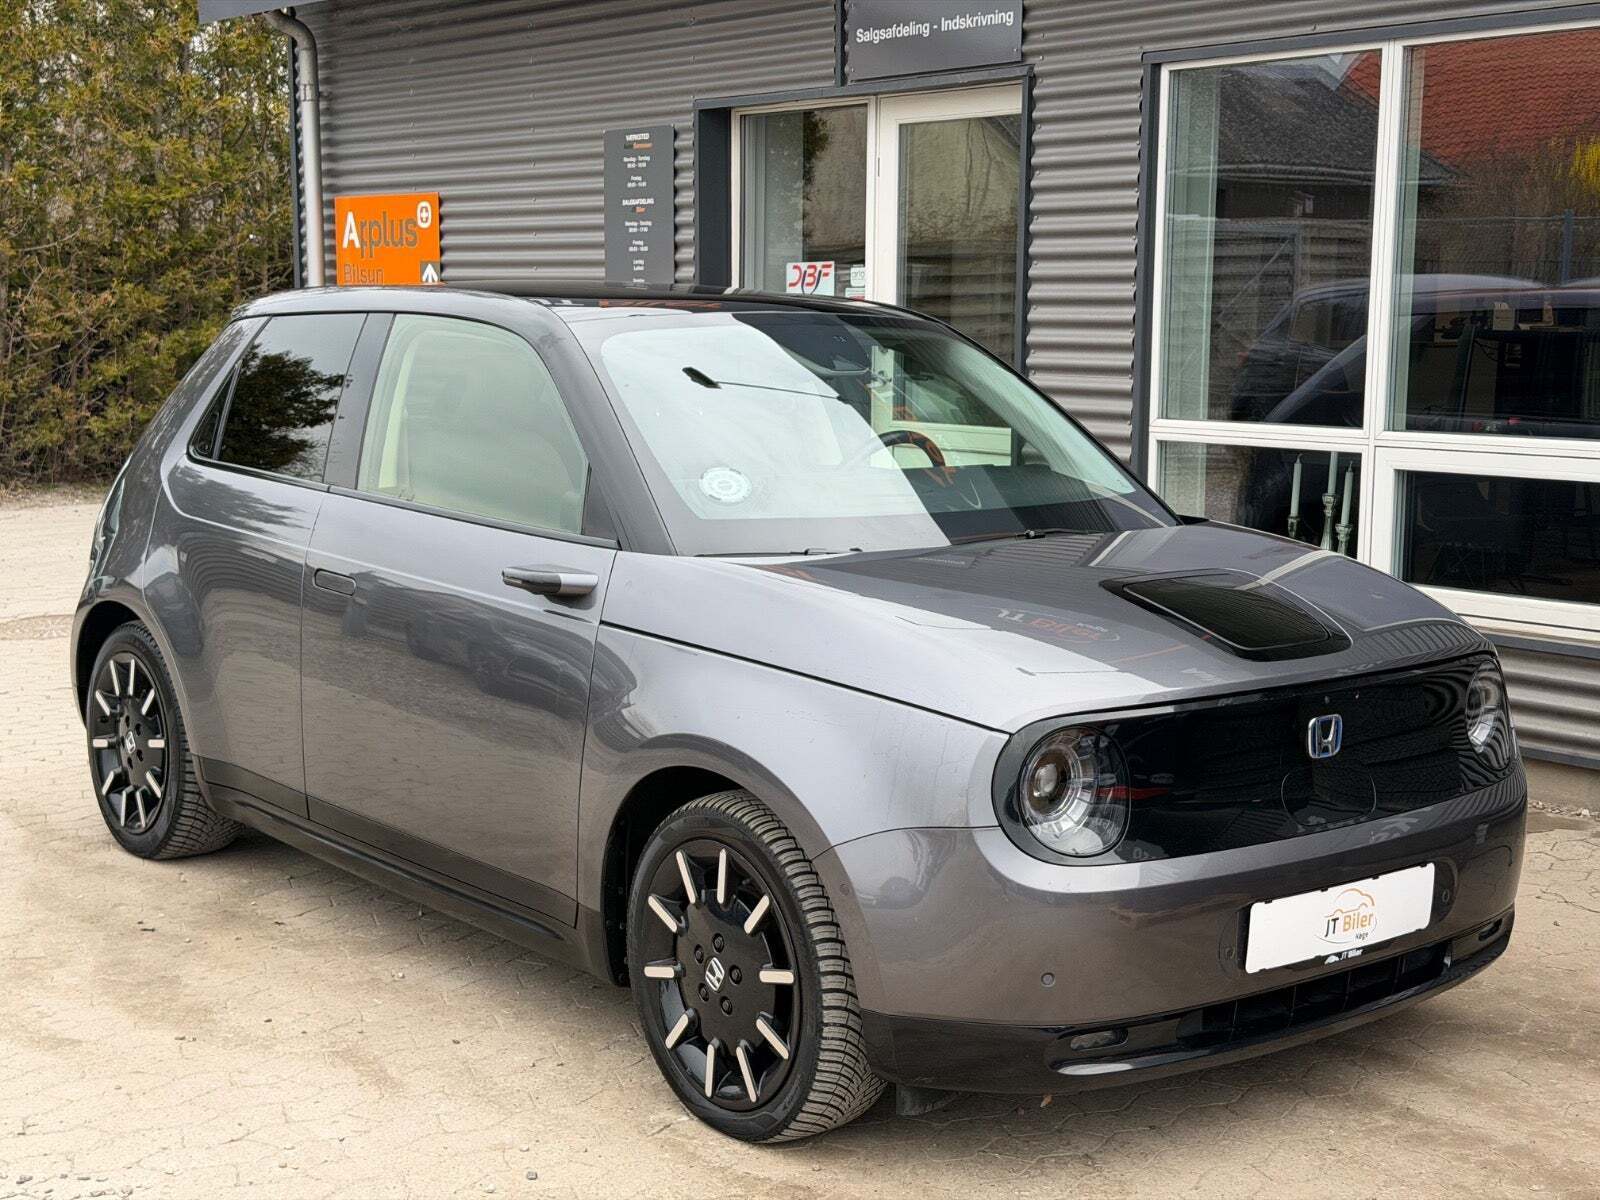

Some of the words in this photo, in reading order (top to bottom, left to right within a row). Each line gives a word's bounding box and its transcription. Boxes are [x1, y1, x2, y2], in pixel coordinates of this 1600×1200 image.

[856, 21, 930, 44] Salgsafdeling
[941, 10, 1014, 32] Indskrivning
[1324, 917, 1339, 937] JT
[1343, 912, 1373, 932] Biler
